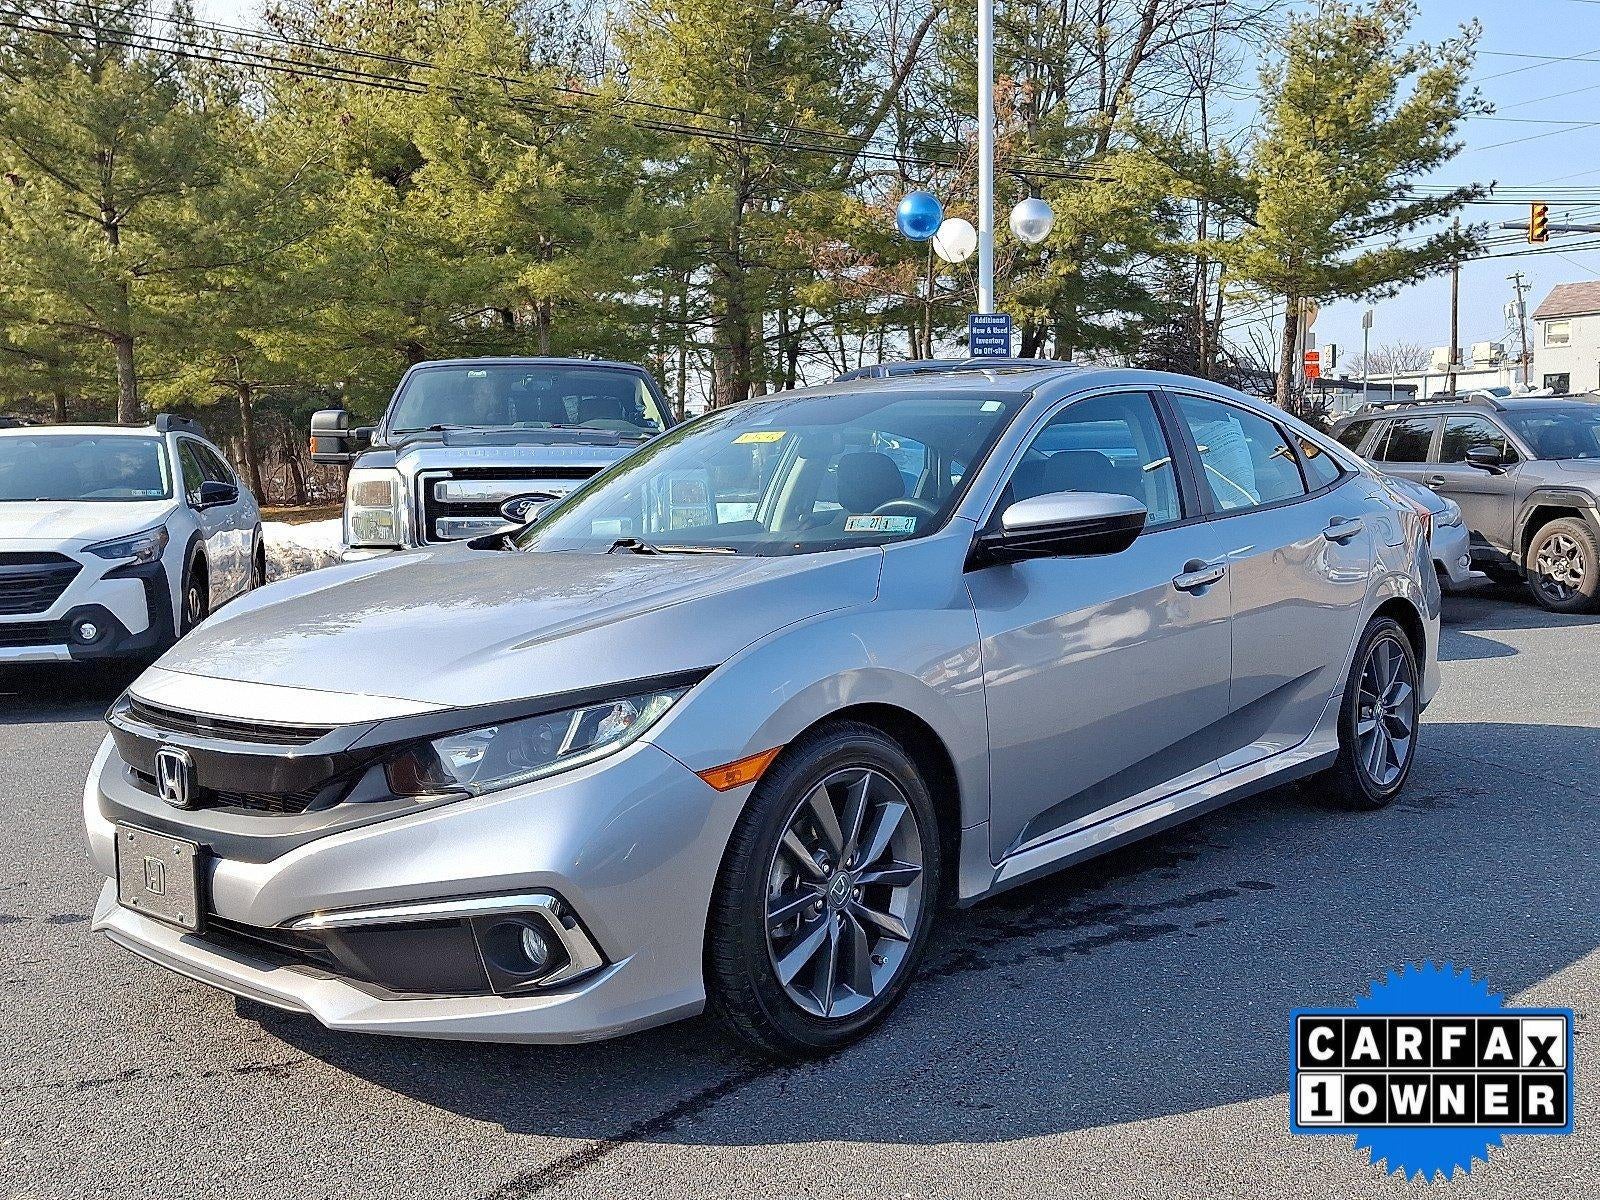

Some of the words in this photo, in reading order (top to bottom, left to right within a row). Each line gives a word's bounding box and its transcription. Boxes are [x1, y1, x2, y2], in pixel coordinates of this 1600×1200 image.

[972, 326, 986, 334] New
[986, 326, 992, 334] &
[993, 326, 1008, 334] Used
[976, 337, 1005, 346] Inventory
[983, 347, 1007, 355] Off-site
